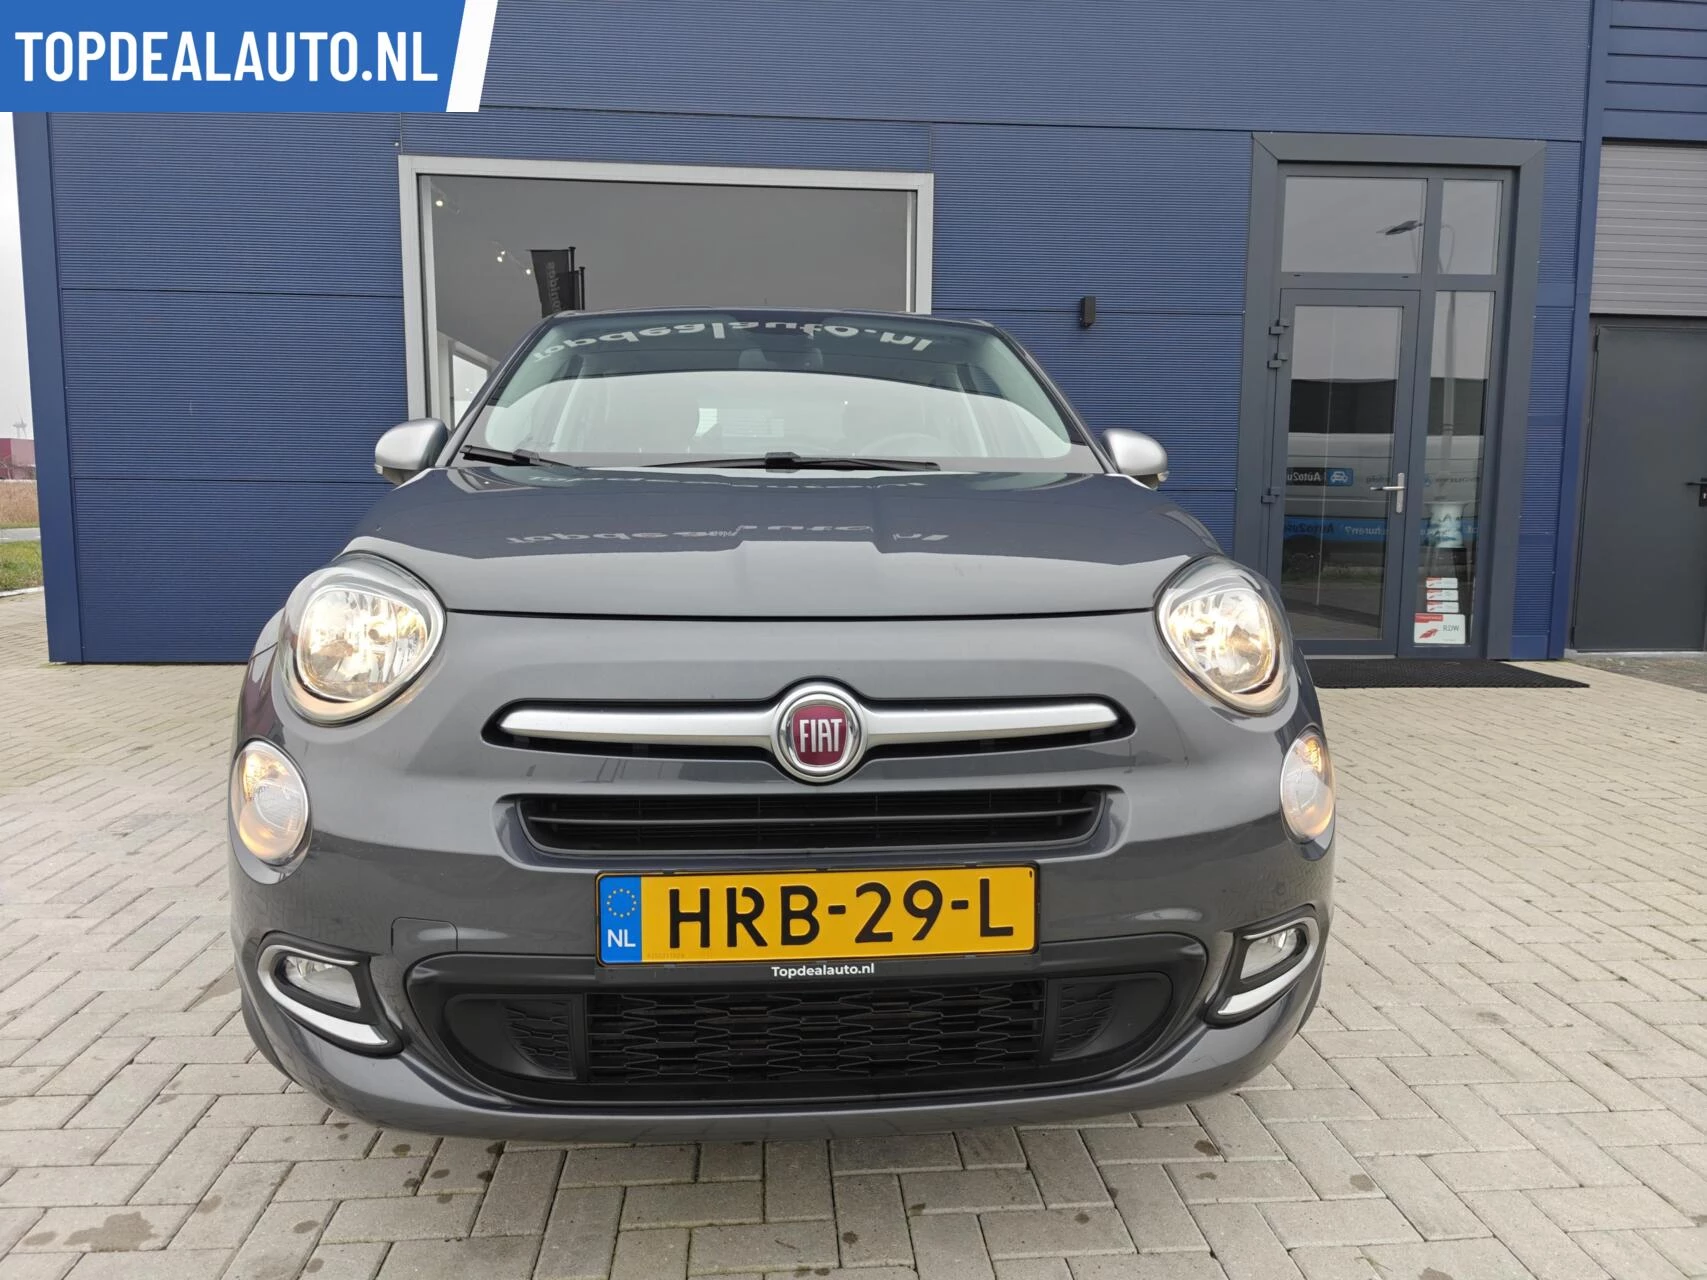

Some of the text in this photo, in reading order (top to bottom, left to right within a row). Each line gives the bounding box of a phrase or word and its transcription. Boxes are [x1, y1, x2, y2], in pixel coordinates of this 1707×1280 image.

[1442, 624, 1460, 632] RDW
[799, 718, 843, 753] FIAT
[668, 878, 1014, 949] HRB-29-L
[607, 928, 636, 948] NL
[771, 963, 875, 979] Topdealauto.nl
